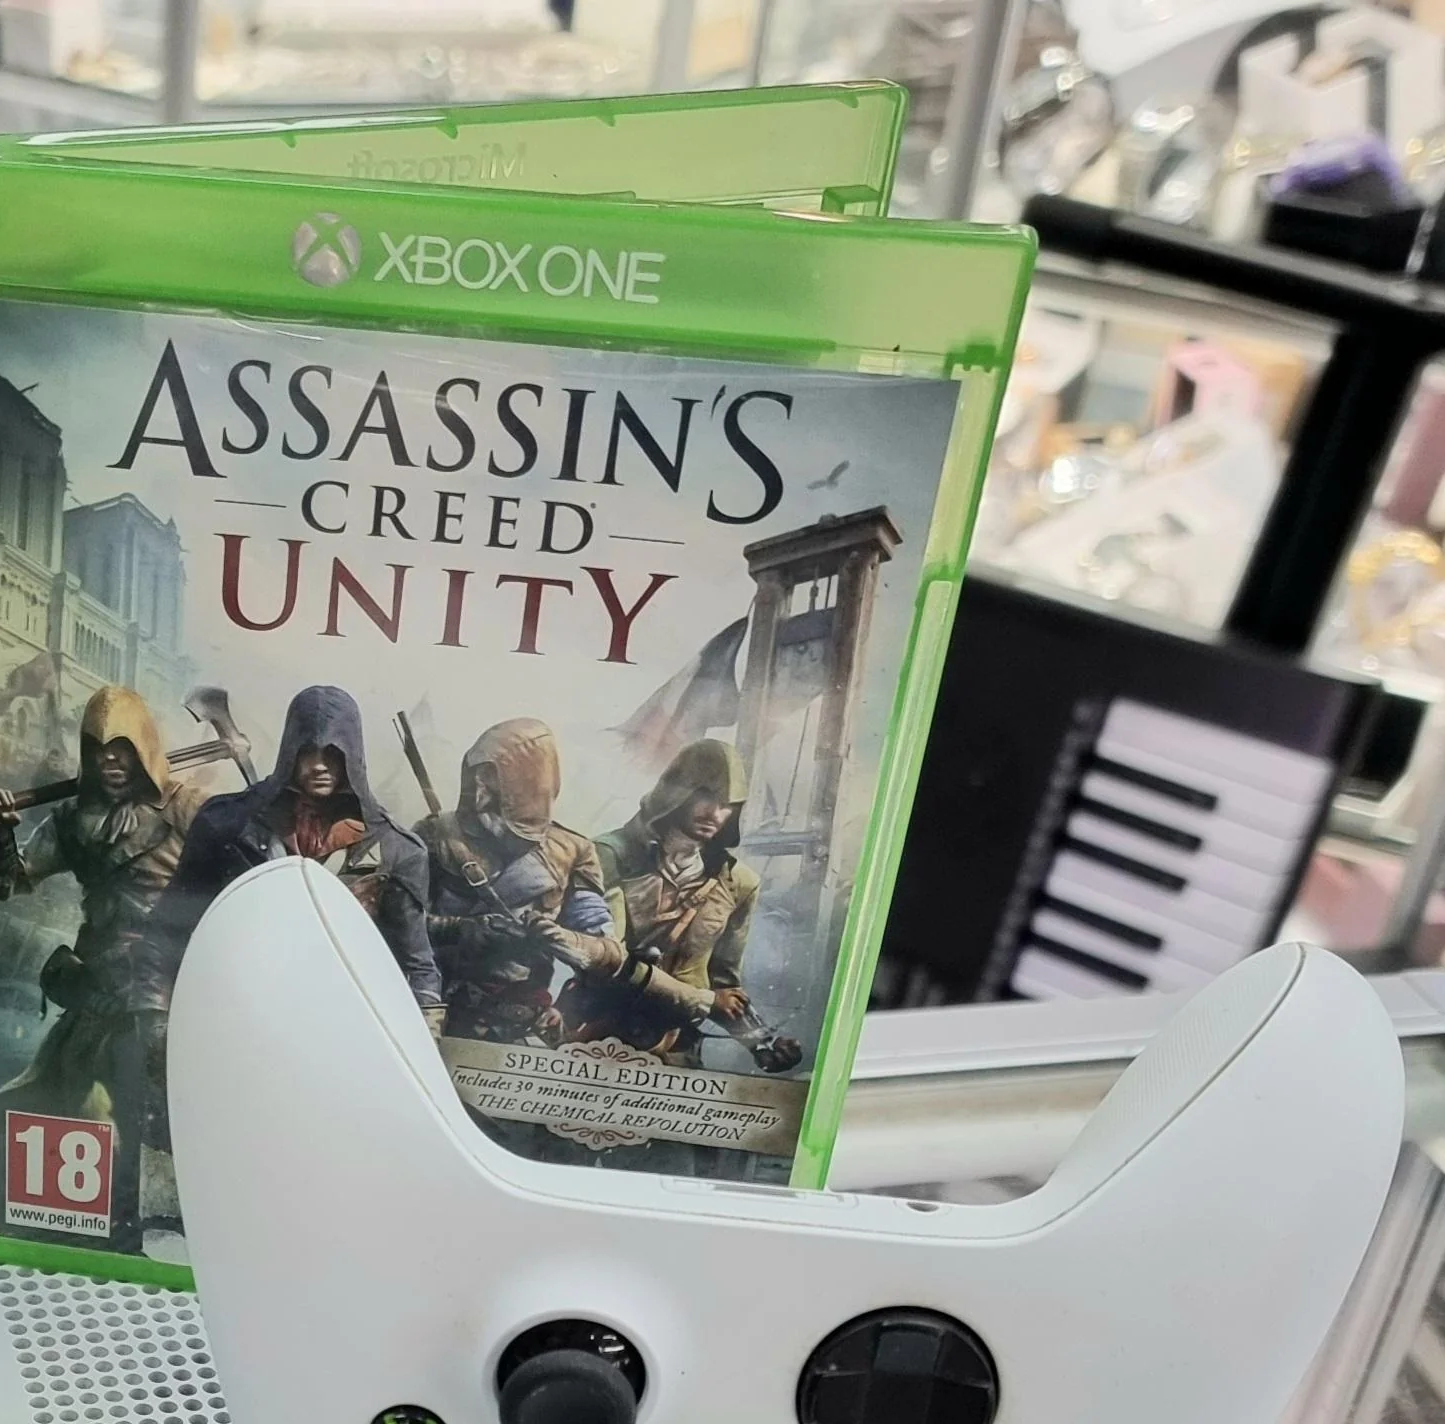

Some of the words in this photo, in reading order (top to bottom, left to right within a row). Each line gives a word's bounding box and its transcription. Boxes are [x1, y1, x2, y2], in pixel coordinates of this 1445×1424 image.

[373, 231, 532, 293] XBOX
[537, 245, 666, 304] ONE
[106, 338, 793, 525] ASSASSIN'S
[300, 480, 591, 554] CREED
[213, 533, 679, 665] UNITY
[506, 1052, 608, 1081] SPECIAL
[616, 1068, 727, 1095] EDITION
[514, 1080, 534, 1093] 30
[537, 1083, 599, 1103] minutes
[603, 1092, 623, 1109] of
[621, 1097, 704, 1117] additional
[702, 1107, 781, 1130] gameplay
[477, 1093, 517, 1110] THE
[520, 1101, 617, 1124] CHEMICAL
[621, 1113, 747, 1140] REVOLUTION
[15, 1125, 101, 1203] 18
[10, 1207, 106, 1231] www.pegi.info
